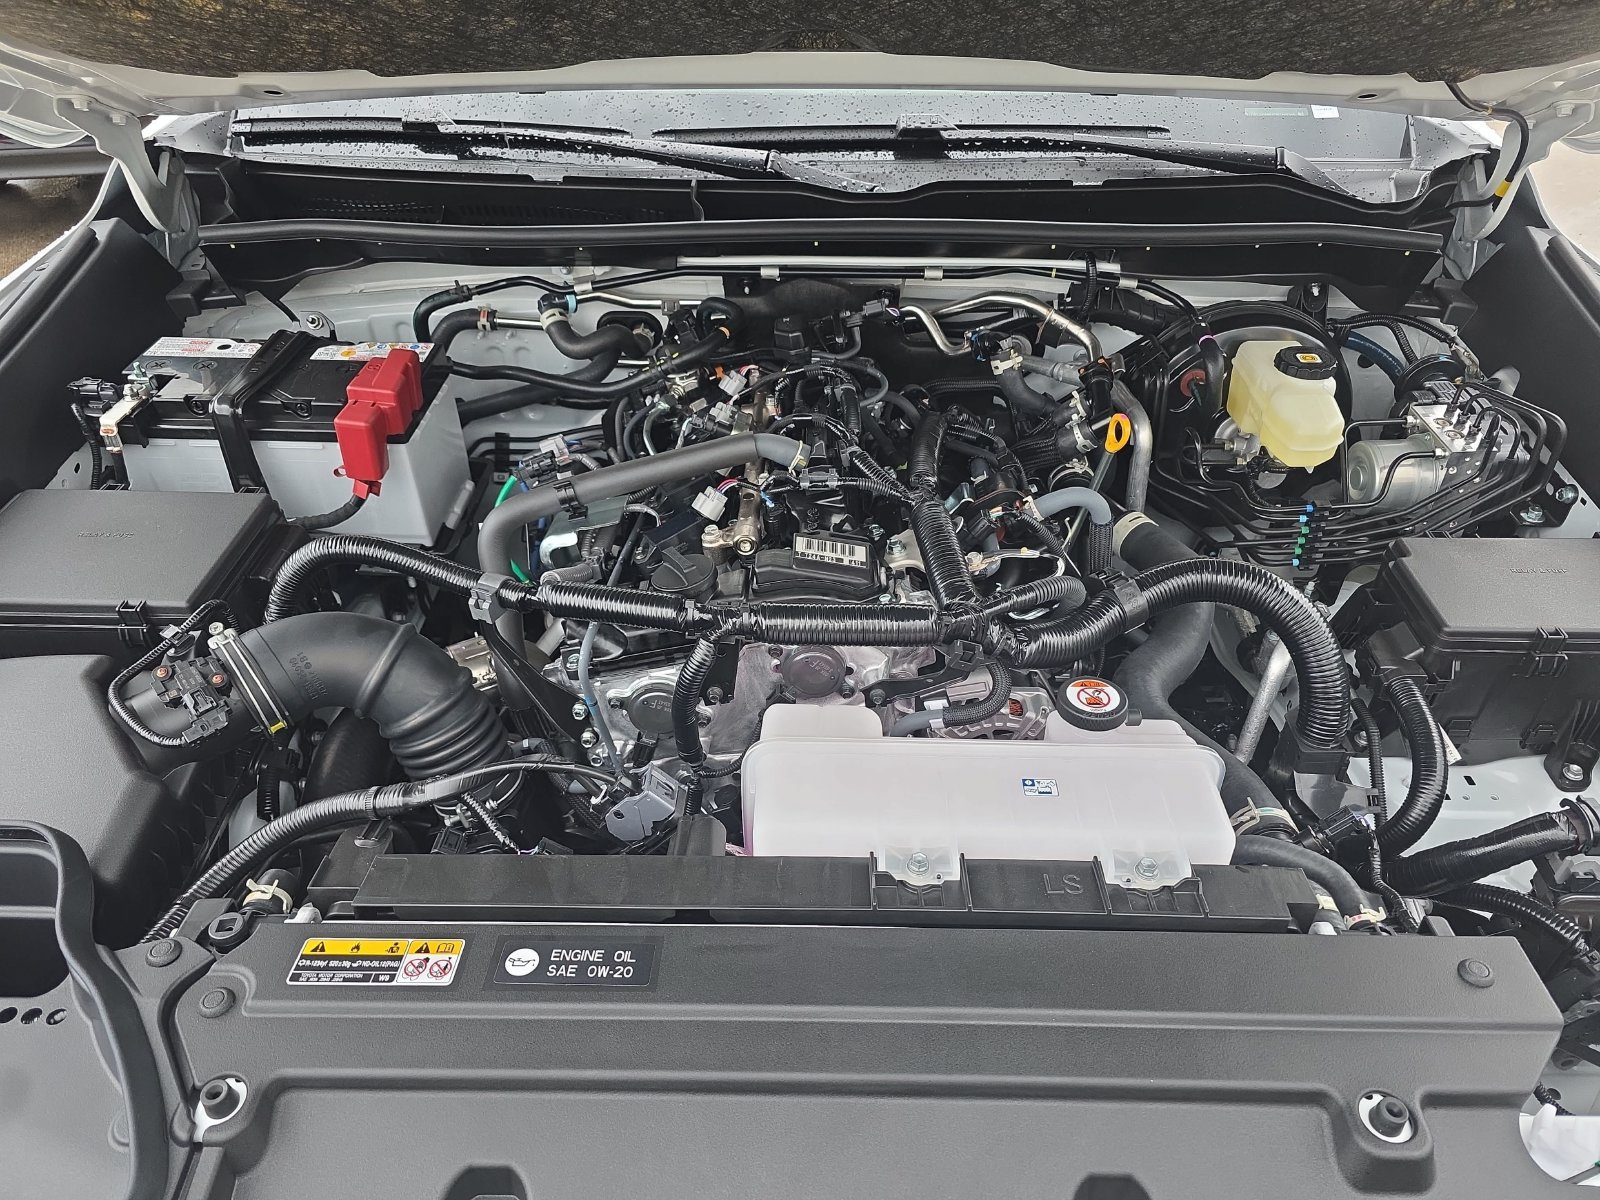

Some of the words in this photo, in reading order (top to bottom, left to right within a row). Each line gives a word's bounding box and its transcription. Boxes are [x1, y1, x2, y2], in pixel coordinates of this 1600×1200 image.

[1043, 873, 1084, 895] LS
[550, 949, 605, 962] ENGINE
[613, 950, 637, 963] OIL
[378, 974, 390, 982] W9
[546, 964, 578, 977] SAE
[587, 965, 634, 978] 0W-20
